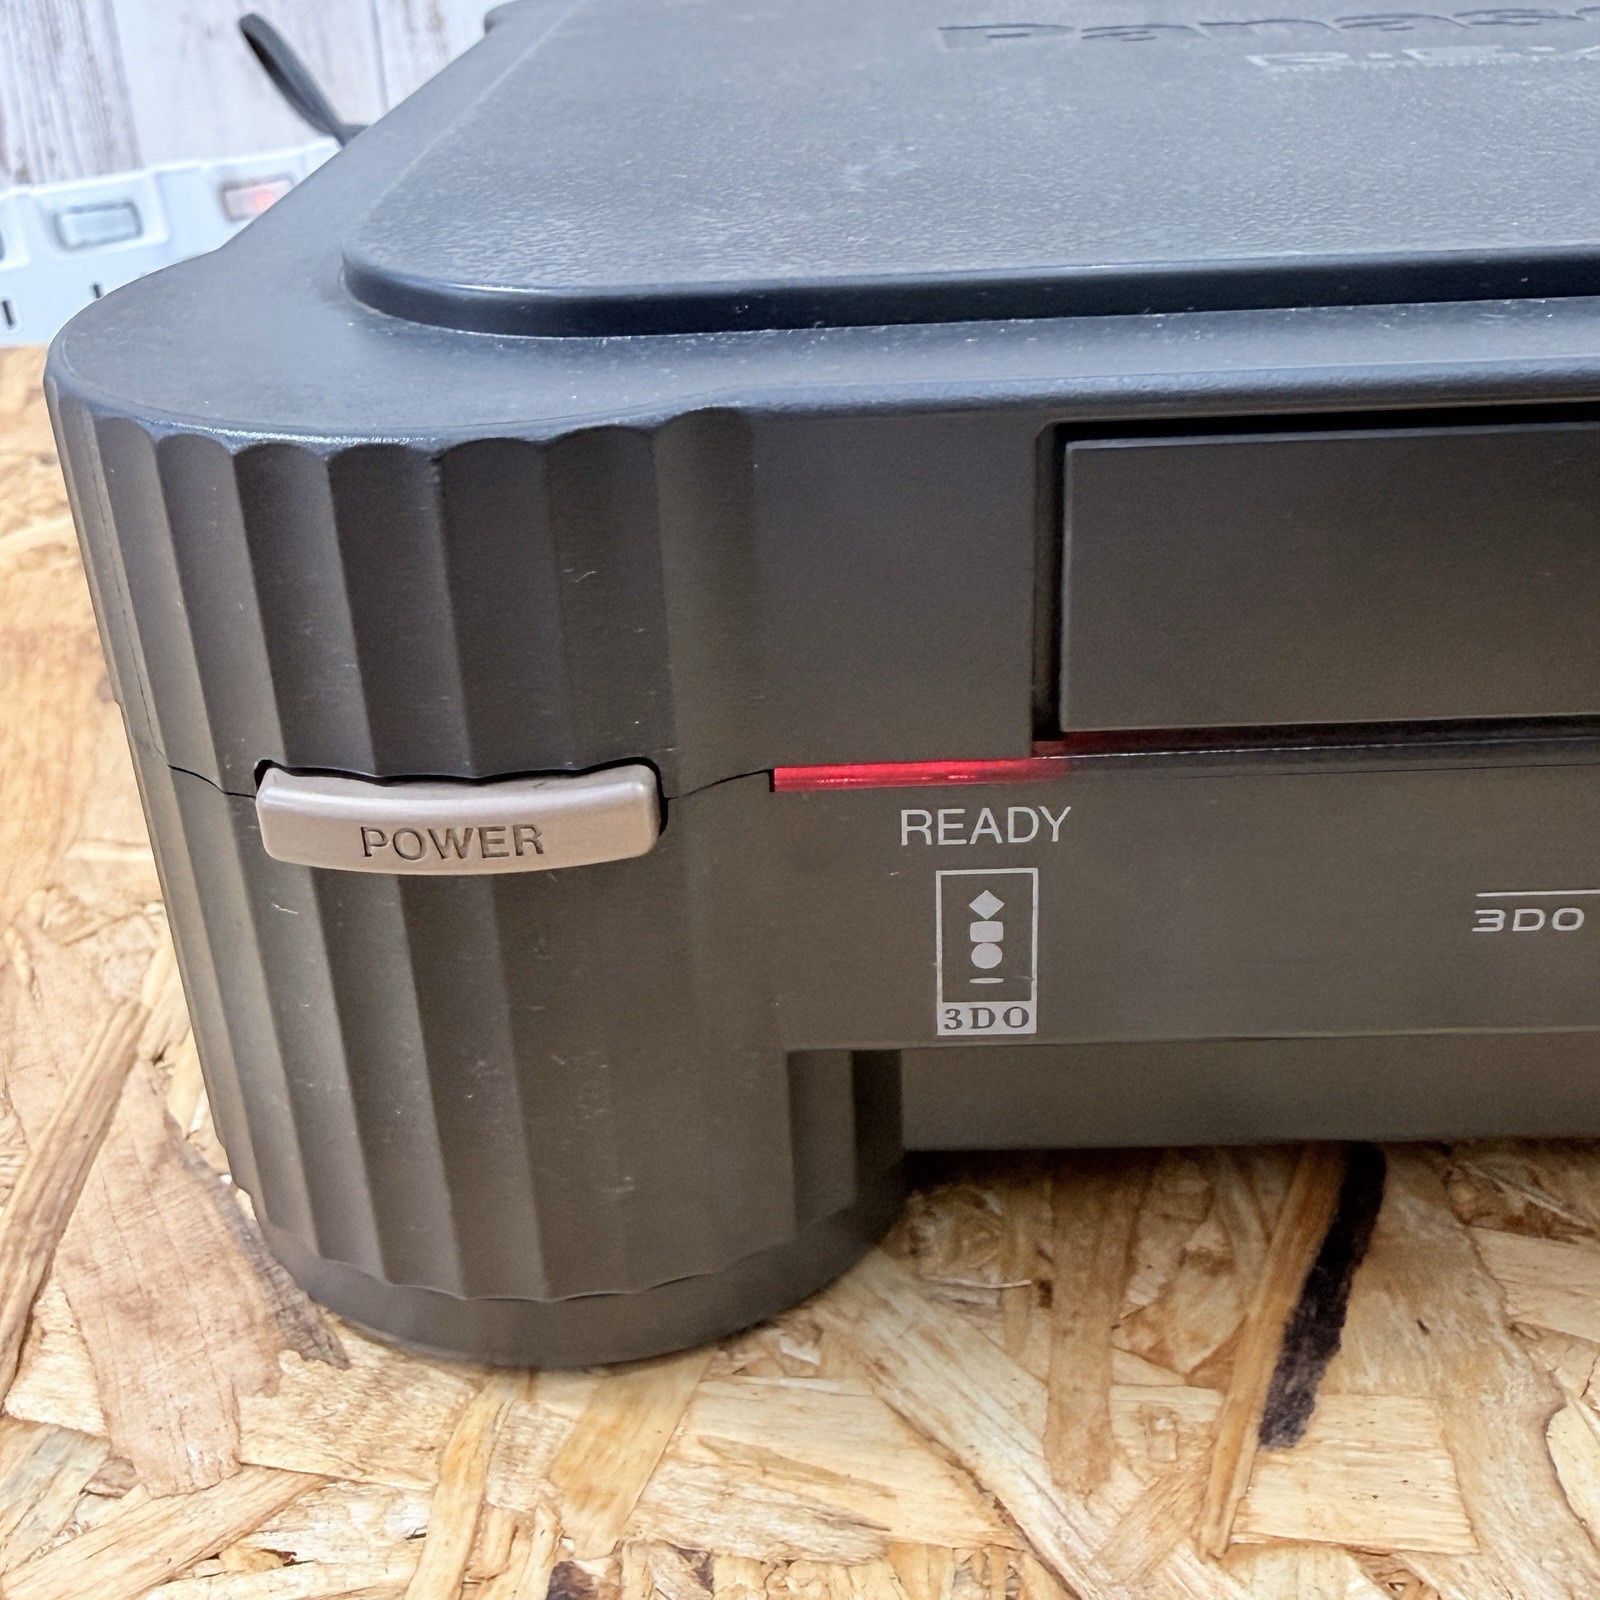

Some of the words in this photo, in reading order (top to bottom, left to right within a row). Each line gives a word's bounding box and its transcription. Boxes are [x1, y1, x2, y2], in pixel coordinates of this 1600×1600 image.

[900, 805, 1072, 846] READY
[360, 823, 545, 861] POWER
[1471, 907, 1585, 932] 3DO
[943, 1006, 1030, 1030] 3DO
